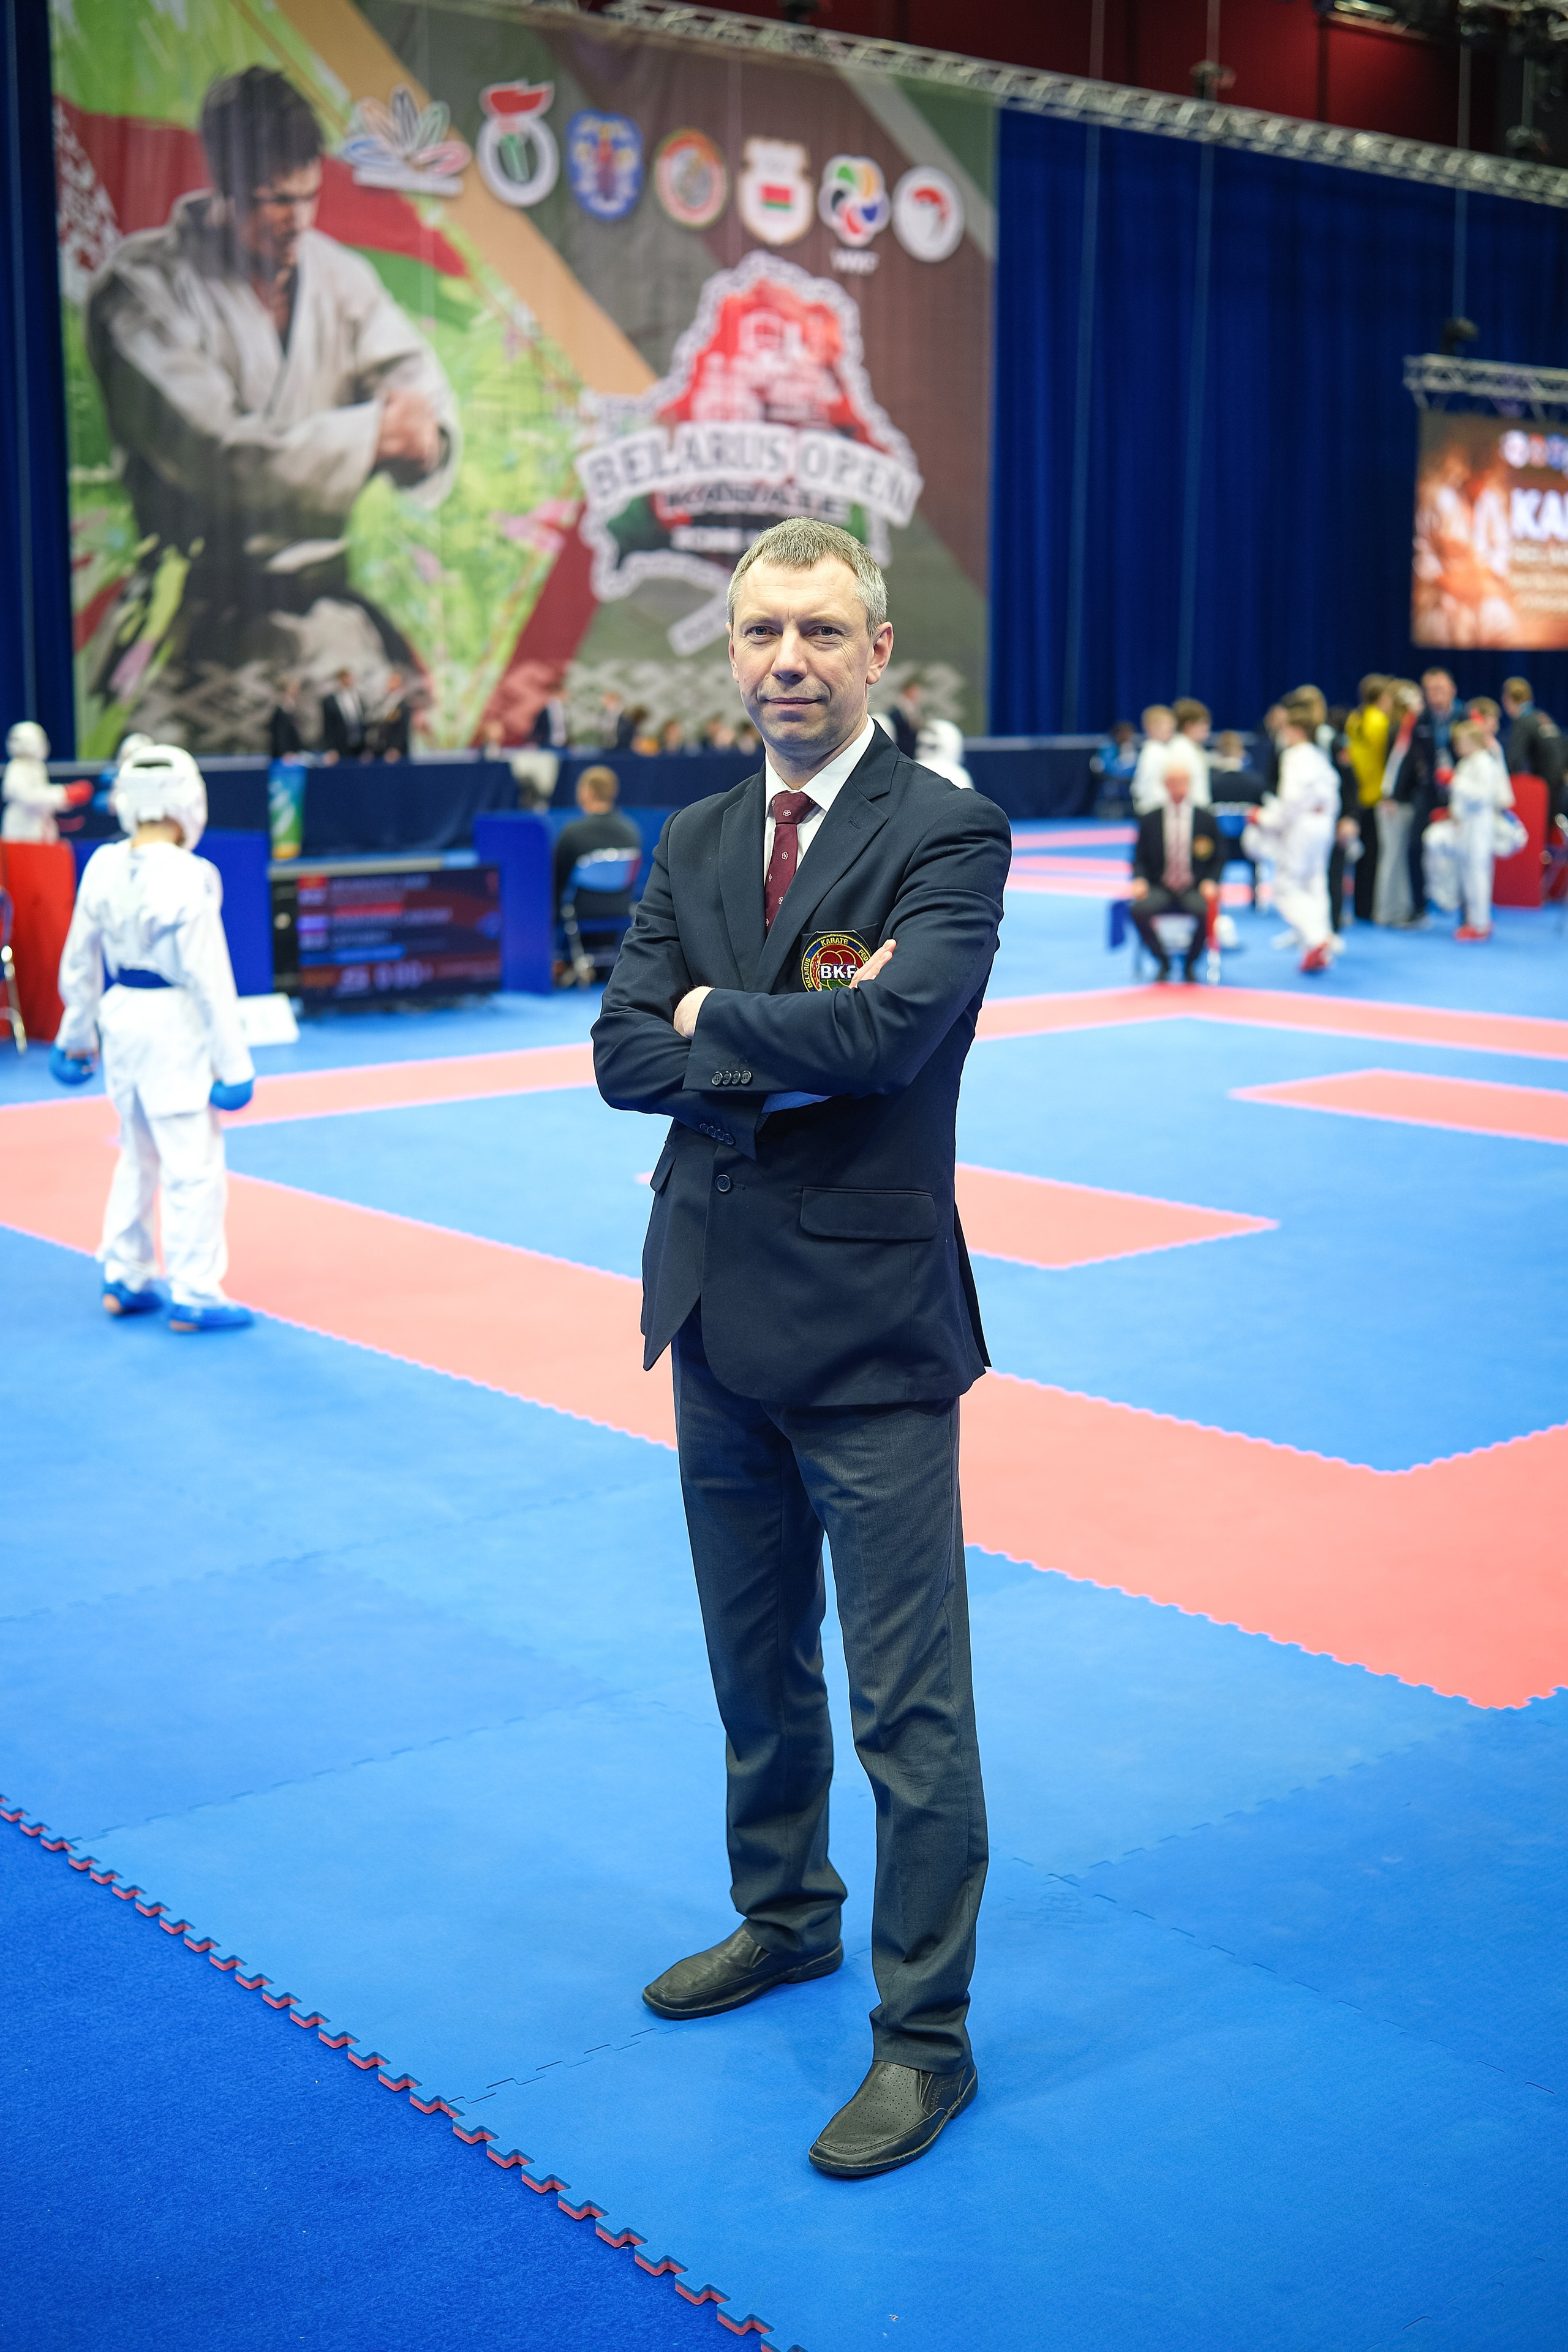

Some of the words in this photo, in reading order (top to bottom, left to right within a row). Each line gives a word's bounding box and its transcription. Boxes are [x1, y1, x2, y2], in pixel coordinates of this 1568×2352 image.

[586, 430, 790, 495] BELARUS
[797, 434, 915, 512] OPEN
[820, 937, 849, 946] KARATE
[820, 965, 856, 979] BKF
